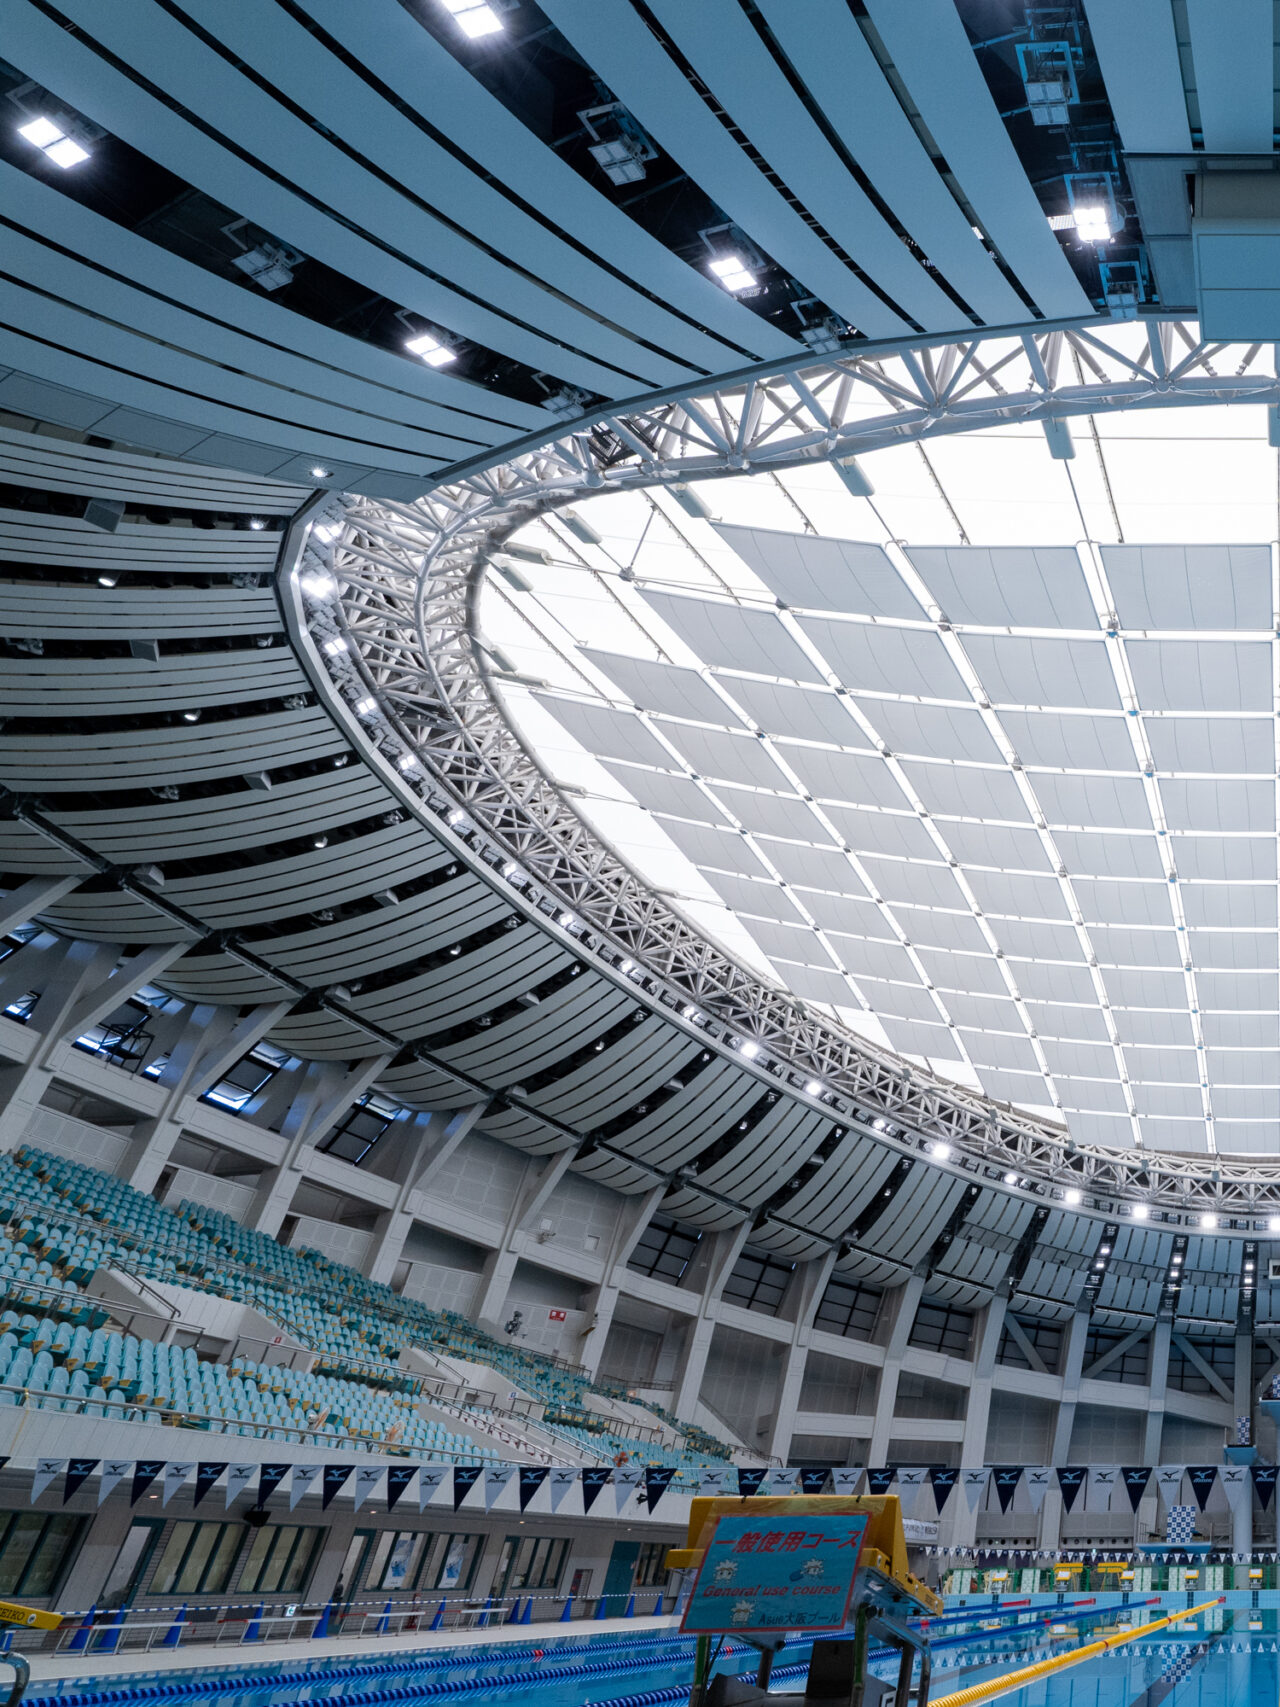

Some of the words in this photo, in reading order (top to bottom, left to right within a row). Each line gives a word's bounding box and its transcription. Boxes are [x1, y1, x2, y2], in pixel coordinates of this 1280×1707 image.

[714, 1530, 863, 1553] 一般使用コース
[703, 1584, 762, 1598] General
[762, 1587, 789, 1597] use
[792, 1585, 841, 1597] course
